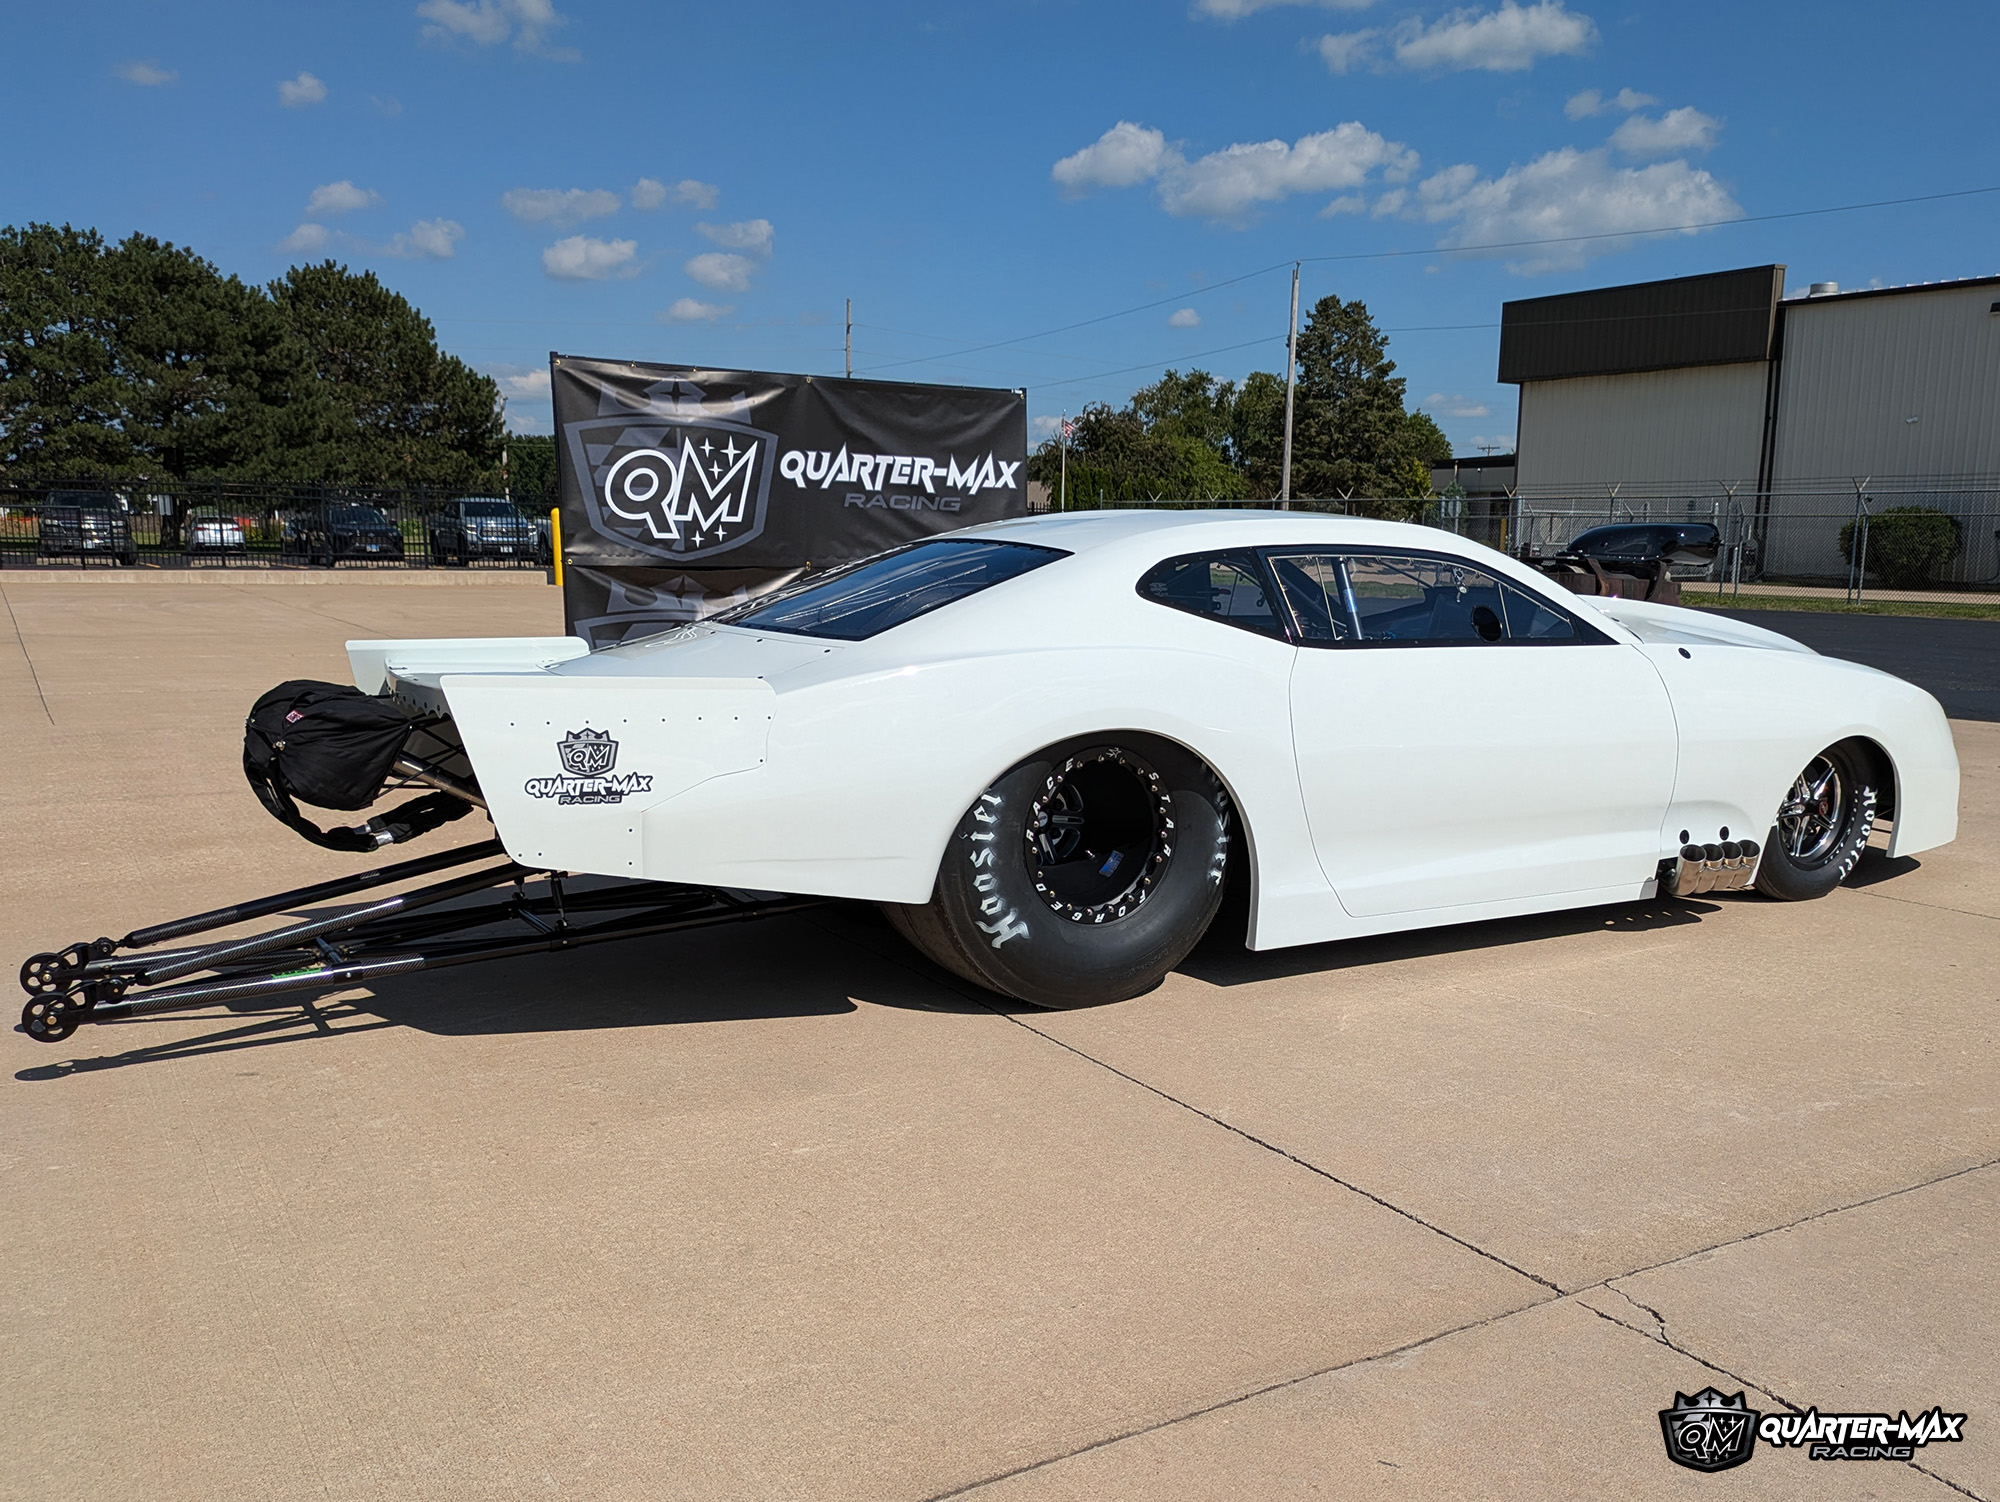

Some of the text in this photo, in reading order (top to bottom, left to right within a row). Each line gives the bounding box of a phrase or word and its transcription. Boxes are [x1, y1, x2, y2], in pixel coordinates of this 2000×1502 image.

[780, 442, 1022, 495] QUARTER-MAX
[605, 436, 758, 539] QM
[844, 493, 961, 512] RACING
[569, 745, 611, 771] QM
[525, 773, 652, 797] QUARTER-MAX
[560, 795, 620, 804] RACING
